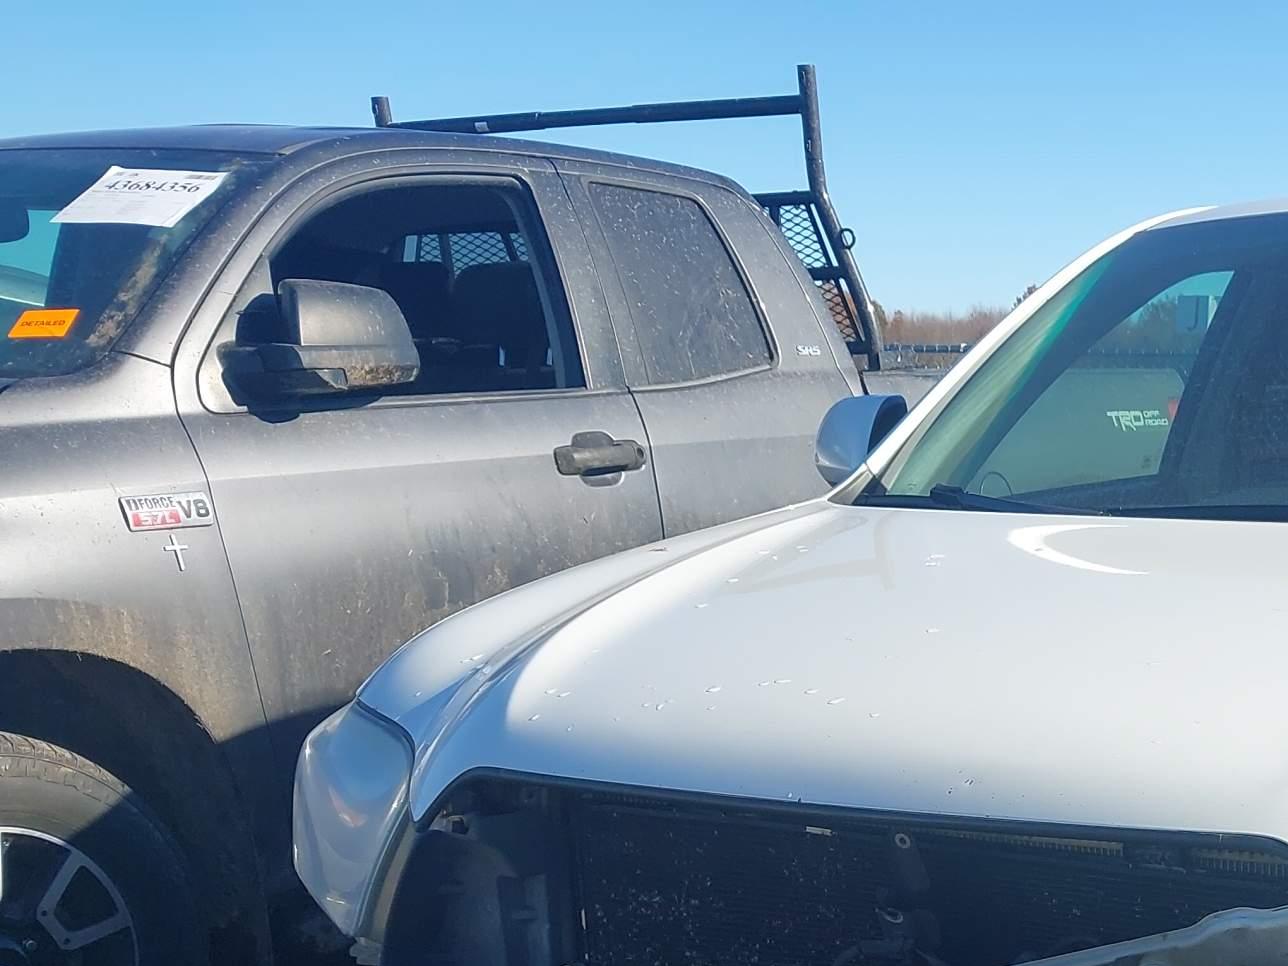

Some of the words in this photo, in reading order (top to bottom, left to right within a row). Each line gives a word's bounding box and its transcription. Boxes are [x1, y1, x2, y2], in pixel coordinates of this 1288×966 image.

[105, 180, 201, 193] 43684356
[21, 320, 66, 328] DETAILED
[1107, 410, 1144, 431] TRD
[1143, 410, 1160, 418] OFF
[1145, 418, 1169, 426] ROAD
[176, 498, 210, 519] V8
